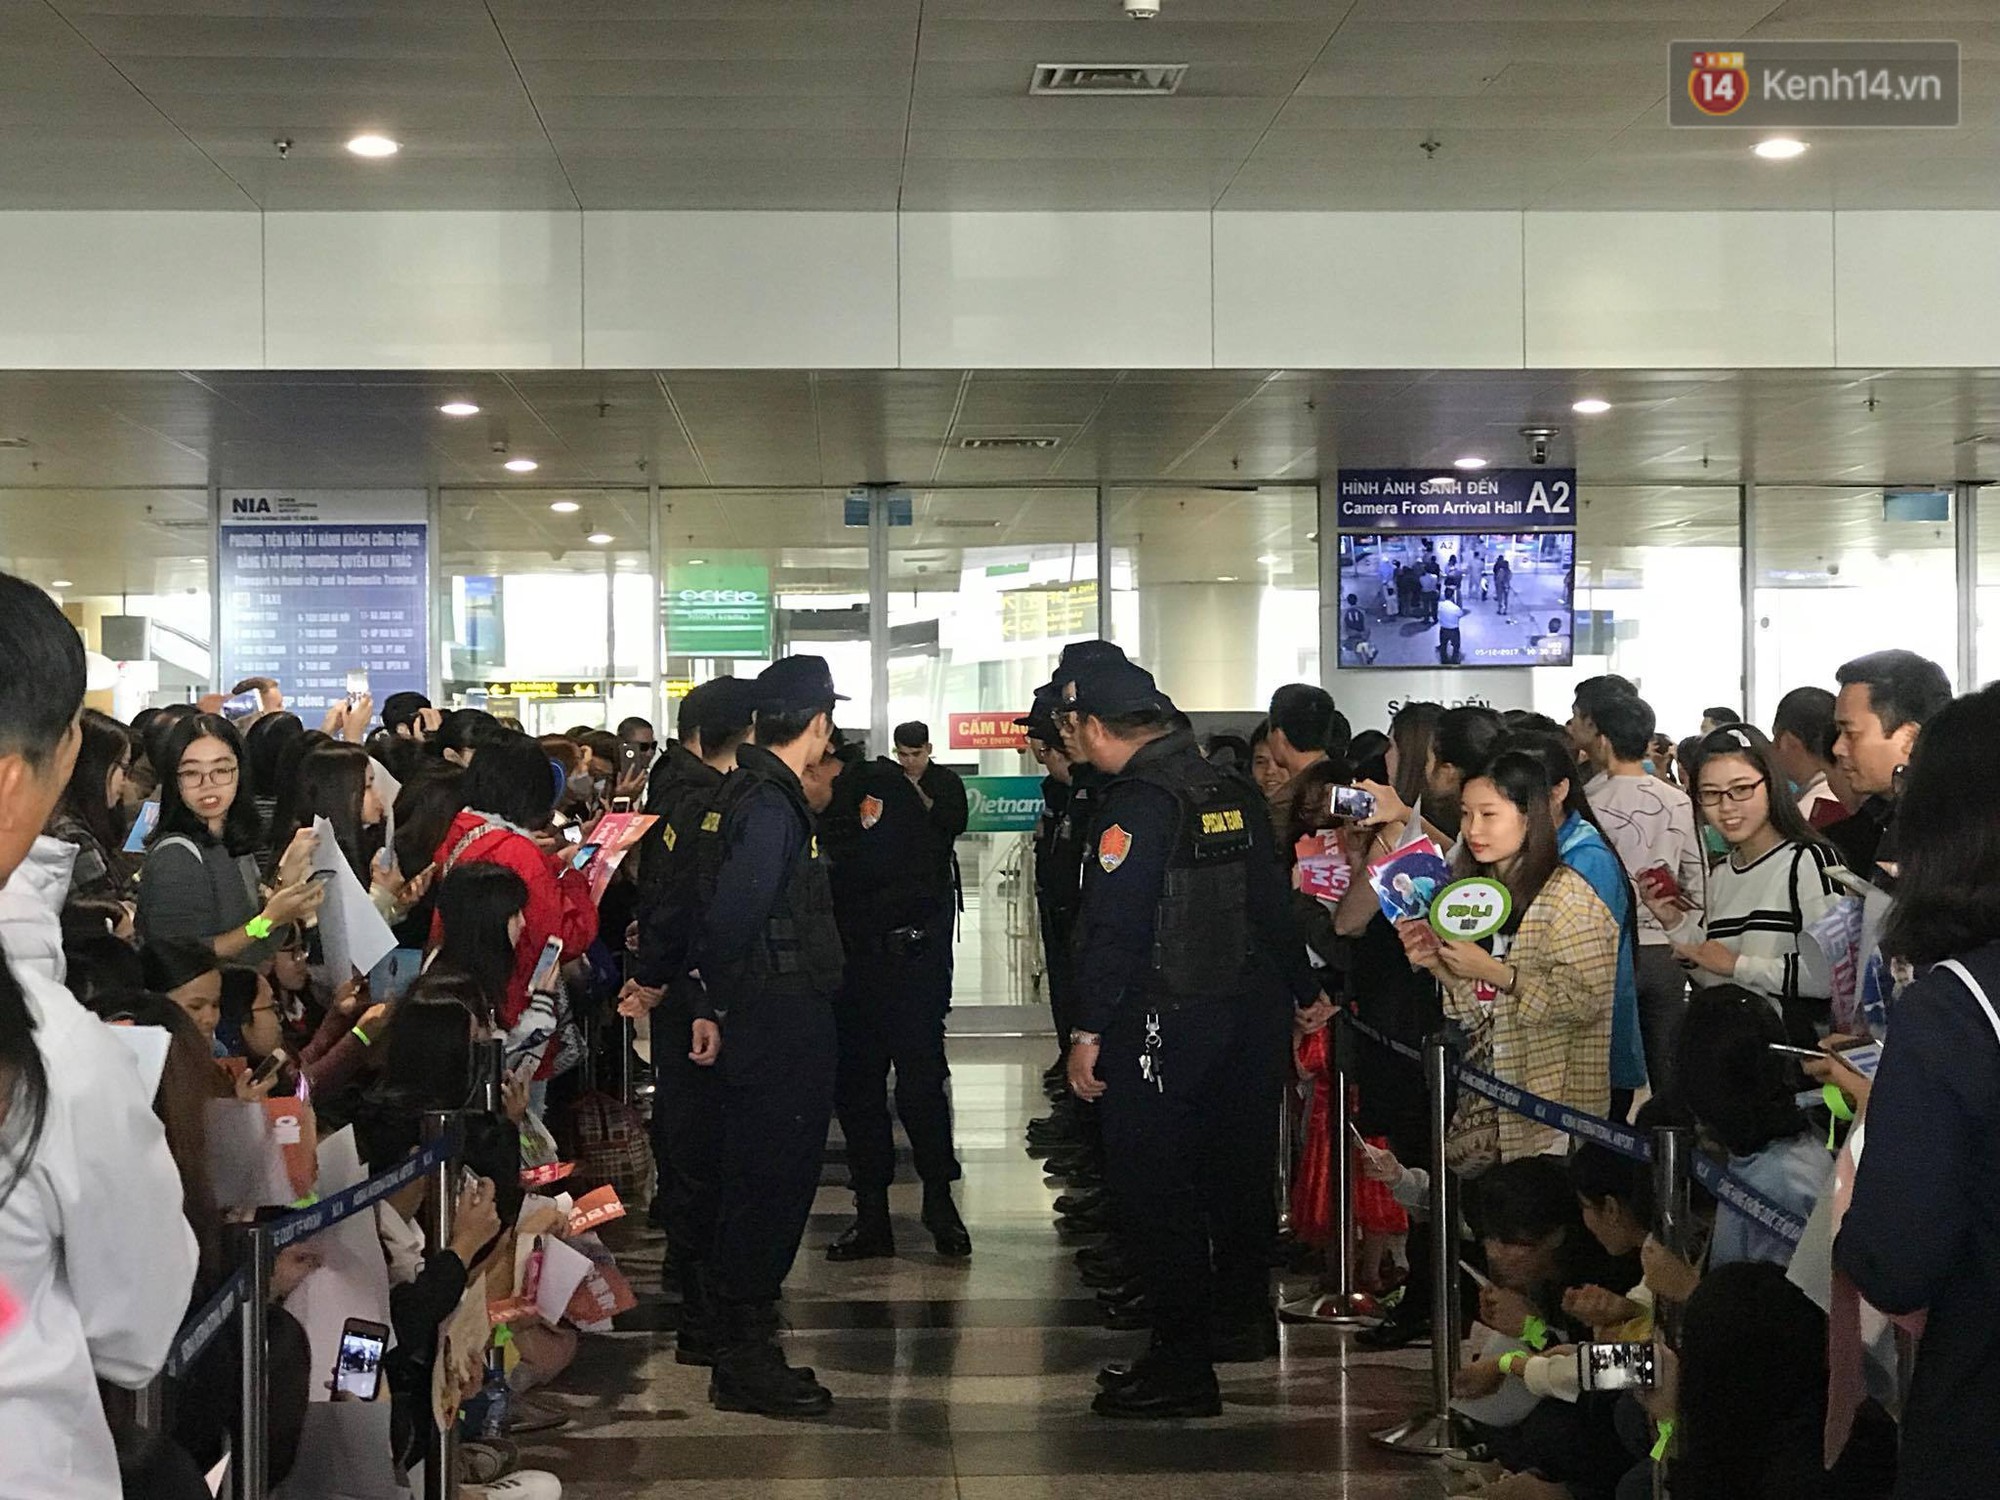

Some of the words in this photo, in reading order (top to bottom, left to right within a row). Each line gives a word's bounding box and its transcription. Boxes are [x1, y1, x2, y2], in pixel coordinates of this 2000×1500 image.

[1342, 477, 1380, 495] HÌNH
[1467, 476, 1499, 495] ĐẾN
[232, 497, 272, 514] NIA
[1526, 481, 1571, 514] A2
[1342, 501, 1398, 514] Camera
[1402, 501, 1440, 514] From
[1443, 501, 1491, 515] Arrival
[1494, 501, 1523, 515] Hall
[1439, 541, 1453, 550] A2
[958, 717, 996, 735] CẤM
[972, 736, 989, 745] NO
[990, 736, 1017, 745] ENTRY
